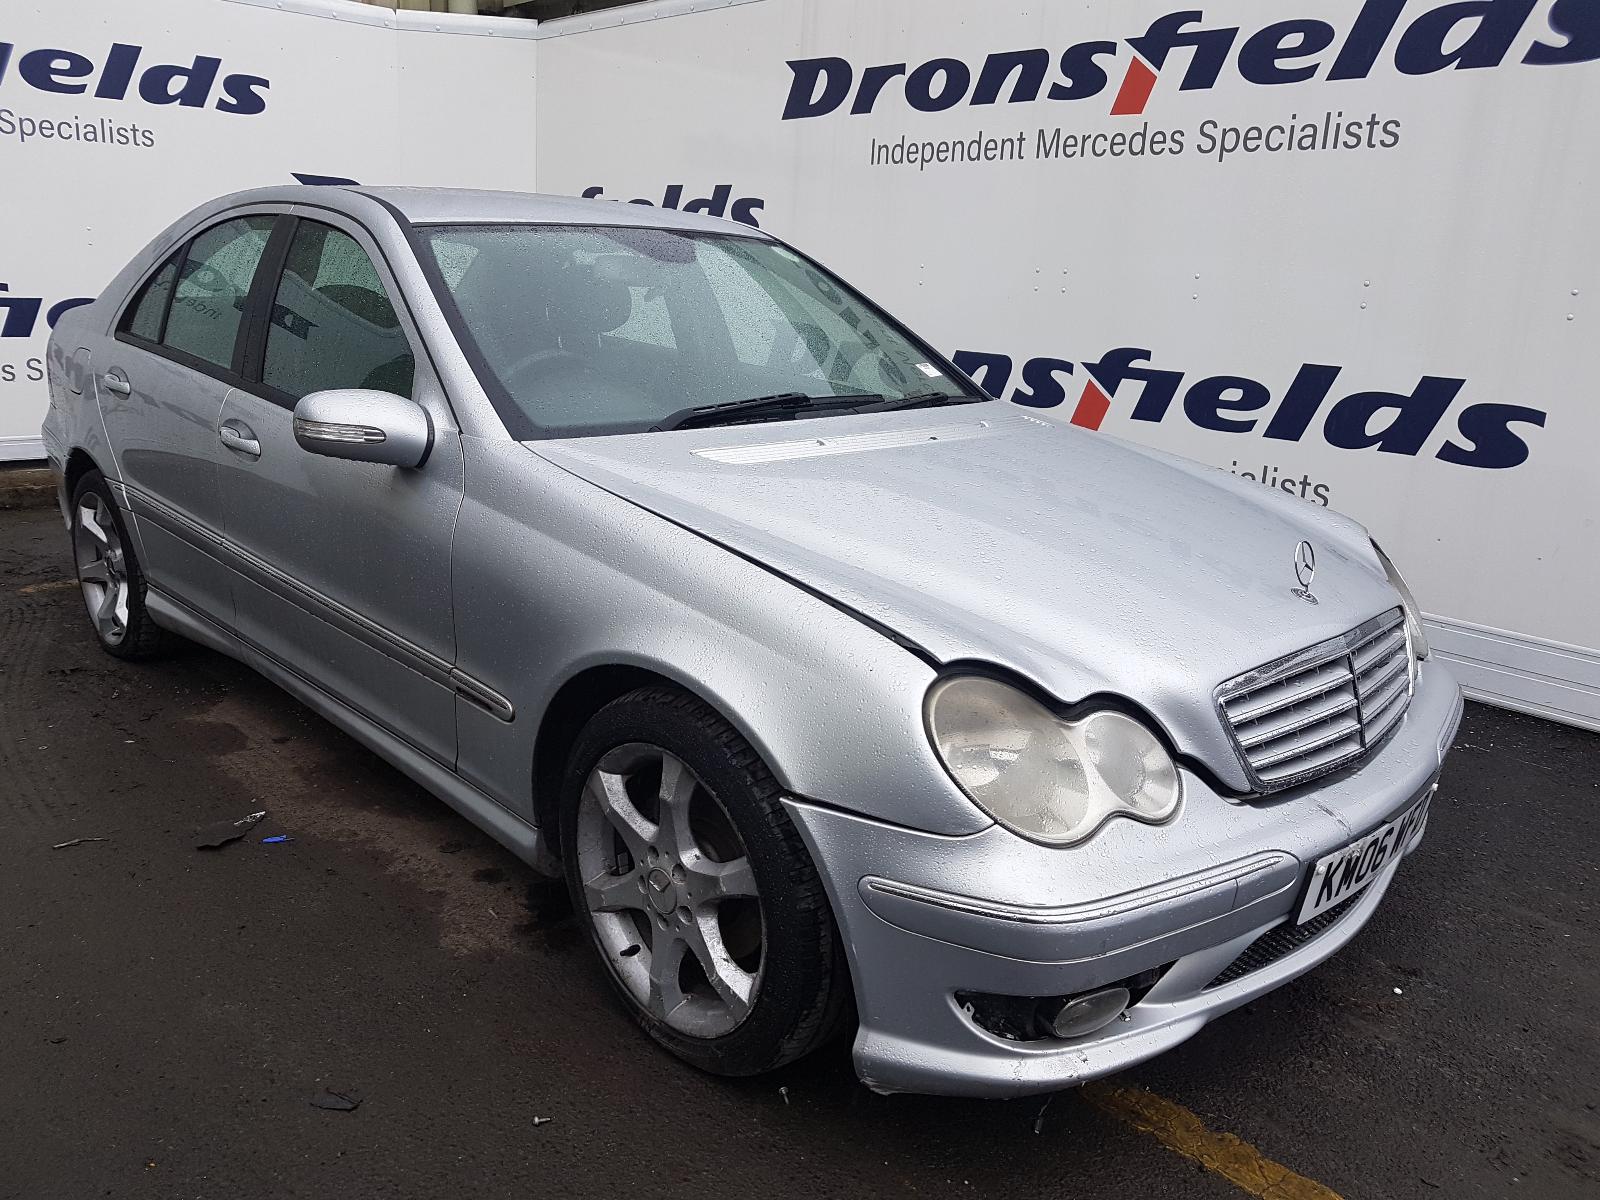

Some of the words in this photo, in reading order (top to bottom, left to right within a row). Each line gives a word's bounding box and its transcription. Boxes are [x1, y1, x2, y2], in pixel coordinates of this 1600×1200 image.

[0, 108, 155, 147] Specialists
[870, 130, 1026, 172] Independent
[1035, 121, 1185, 159] Mercedes
[1196, 111, 1401, 163] Specialists
[1314, 826, 1395, 909] KM06
